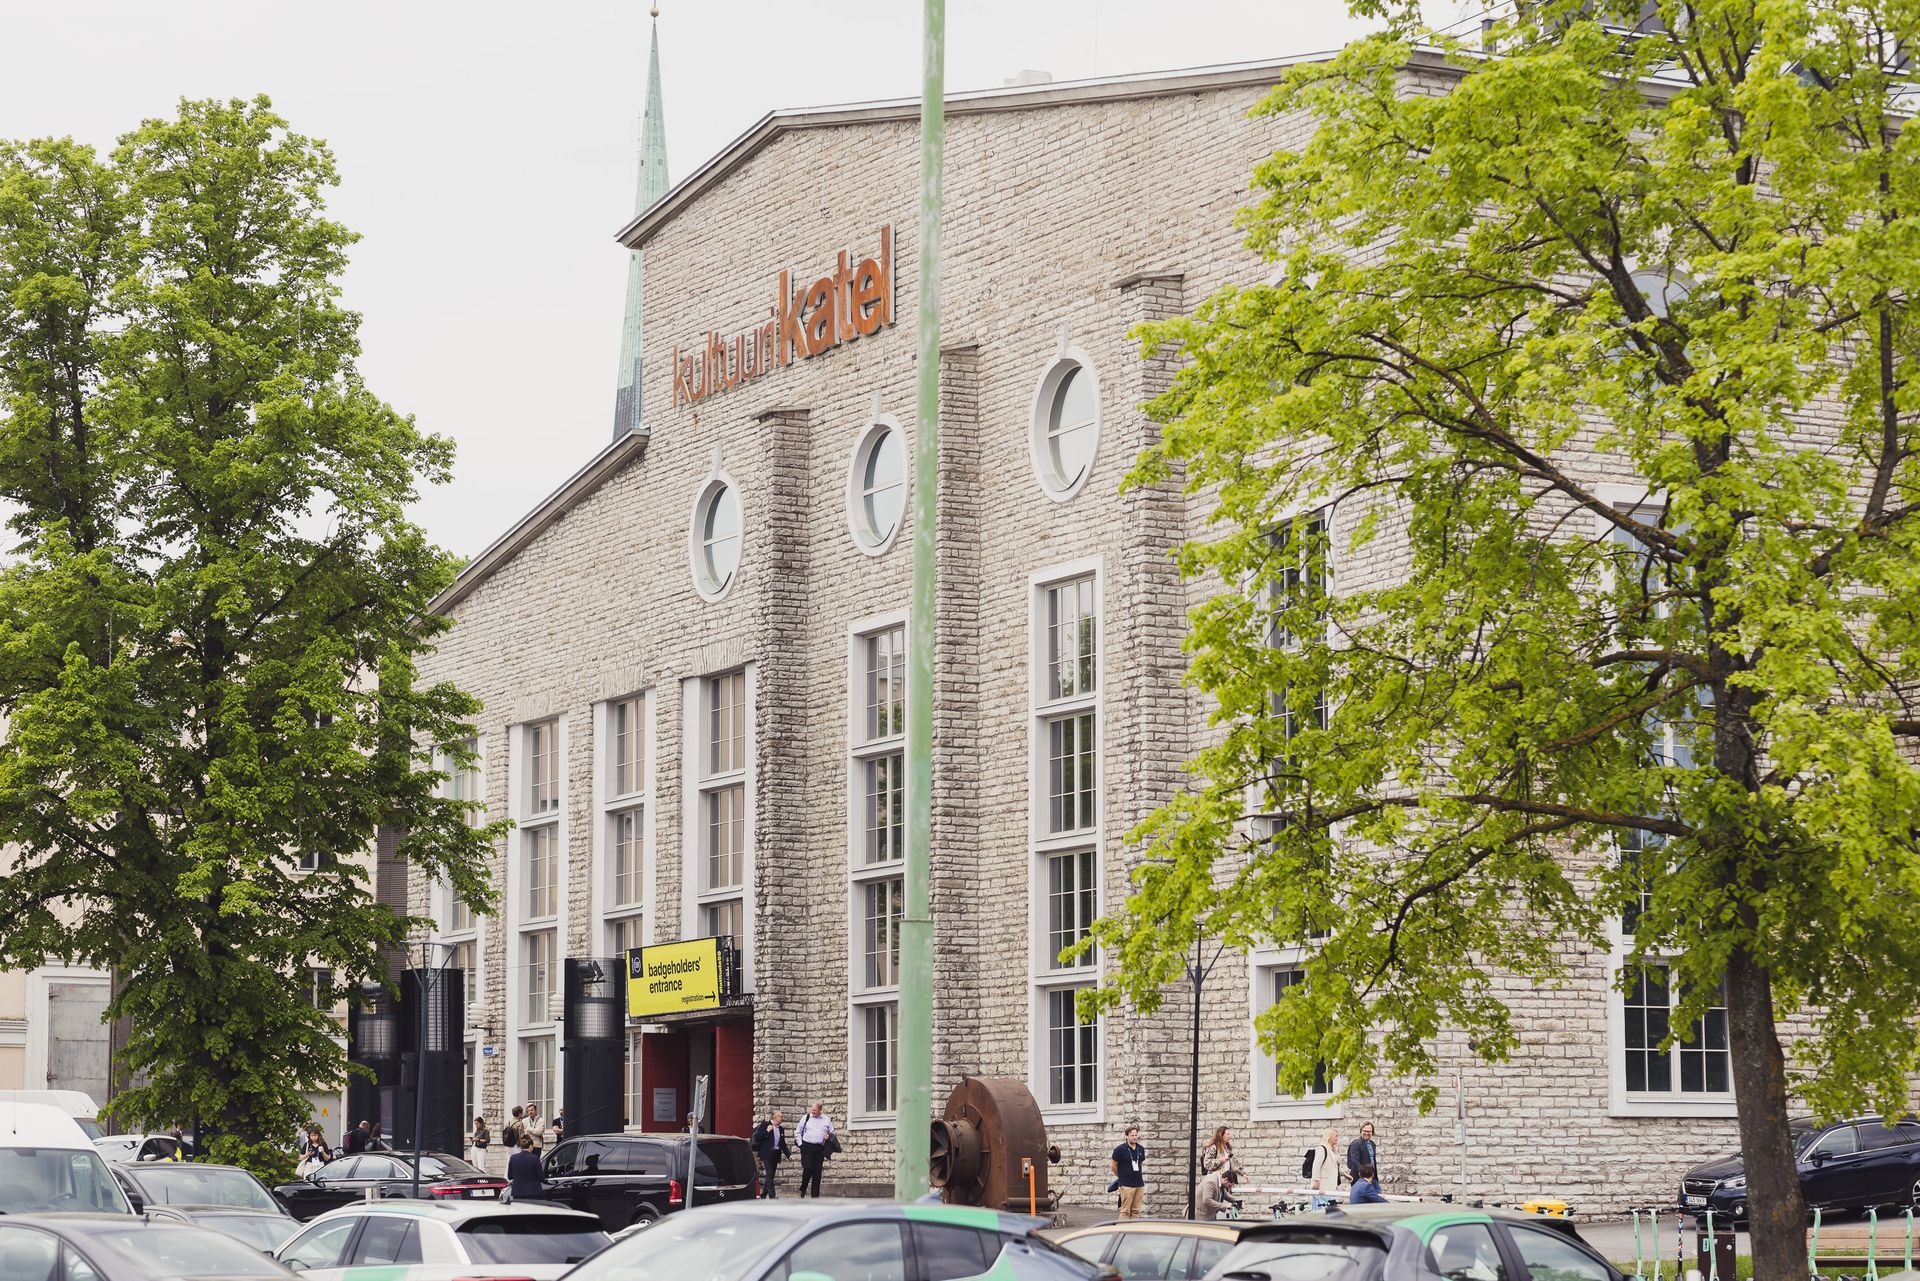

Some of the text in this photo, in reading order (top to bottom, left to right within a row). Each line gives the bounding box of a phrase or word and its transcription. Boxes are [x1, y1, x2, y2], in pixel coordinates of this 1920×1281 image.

[673, 224, 895, 408] kultuurikatel
[648, 957, 701, 979] badgeholders'
[649, 980, 683, 994] entrance
